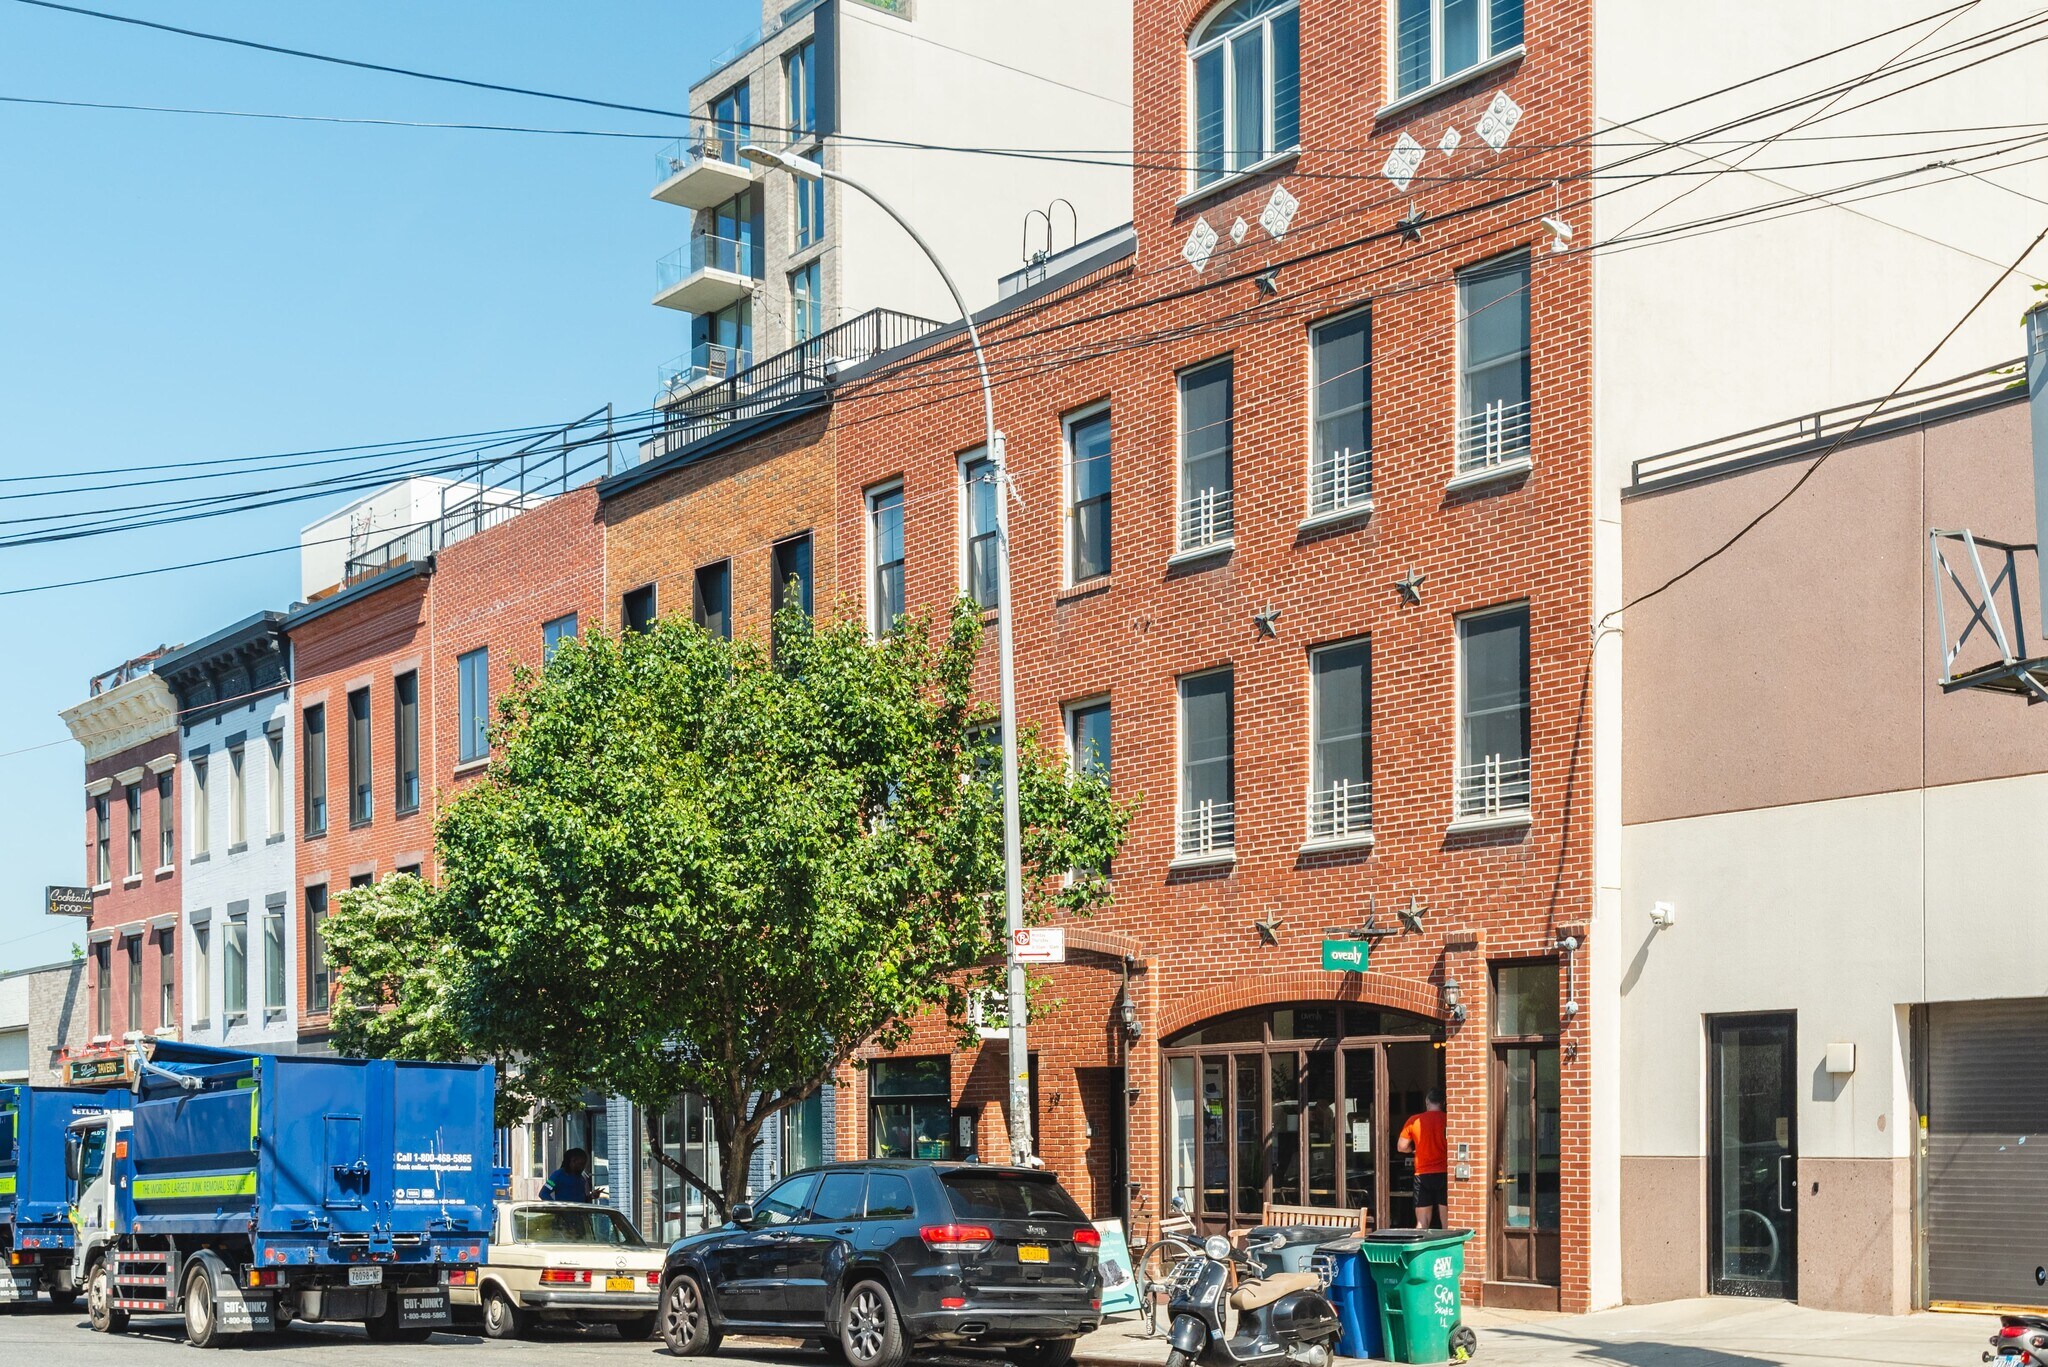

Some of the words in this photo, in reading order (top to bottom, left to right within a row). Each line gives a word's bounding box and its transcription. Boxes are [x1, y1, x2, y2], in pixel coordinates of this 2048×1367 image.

[50, 889, 91, 902] Cocktails
[60, 904, 82, 912] FOOD
[1331, 946, 1362, 965] ovenly
[97, 1062, 117, 1074] TAVERN
[396, 1153, 412, 1162] Call
[413, 1154, 472, 1163] 1-800-468-5865
[151, 1182, 171, 1194] WORLD'S
[172, 1182, 190, 1193] LARGEST
[191, 1181, 202, 1192] JUNK
[203, 1180, 225, 1191] REMOVAL
[227, 1179, 246, 1190] SERVICE
[1026, 1225, 1047, 1236] Jeep
[0, 1279, 31, 1287] OT-JUNK?
